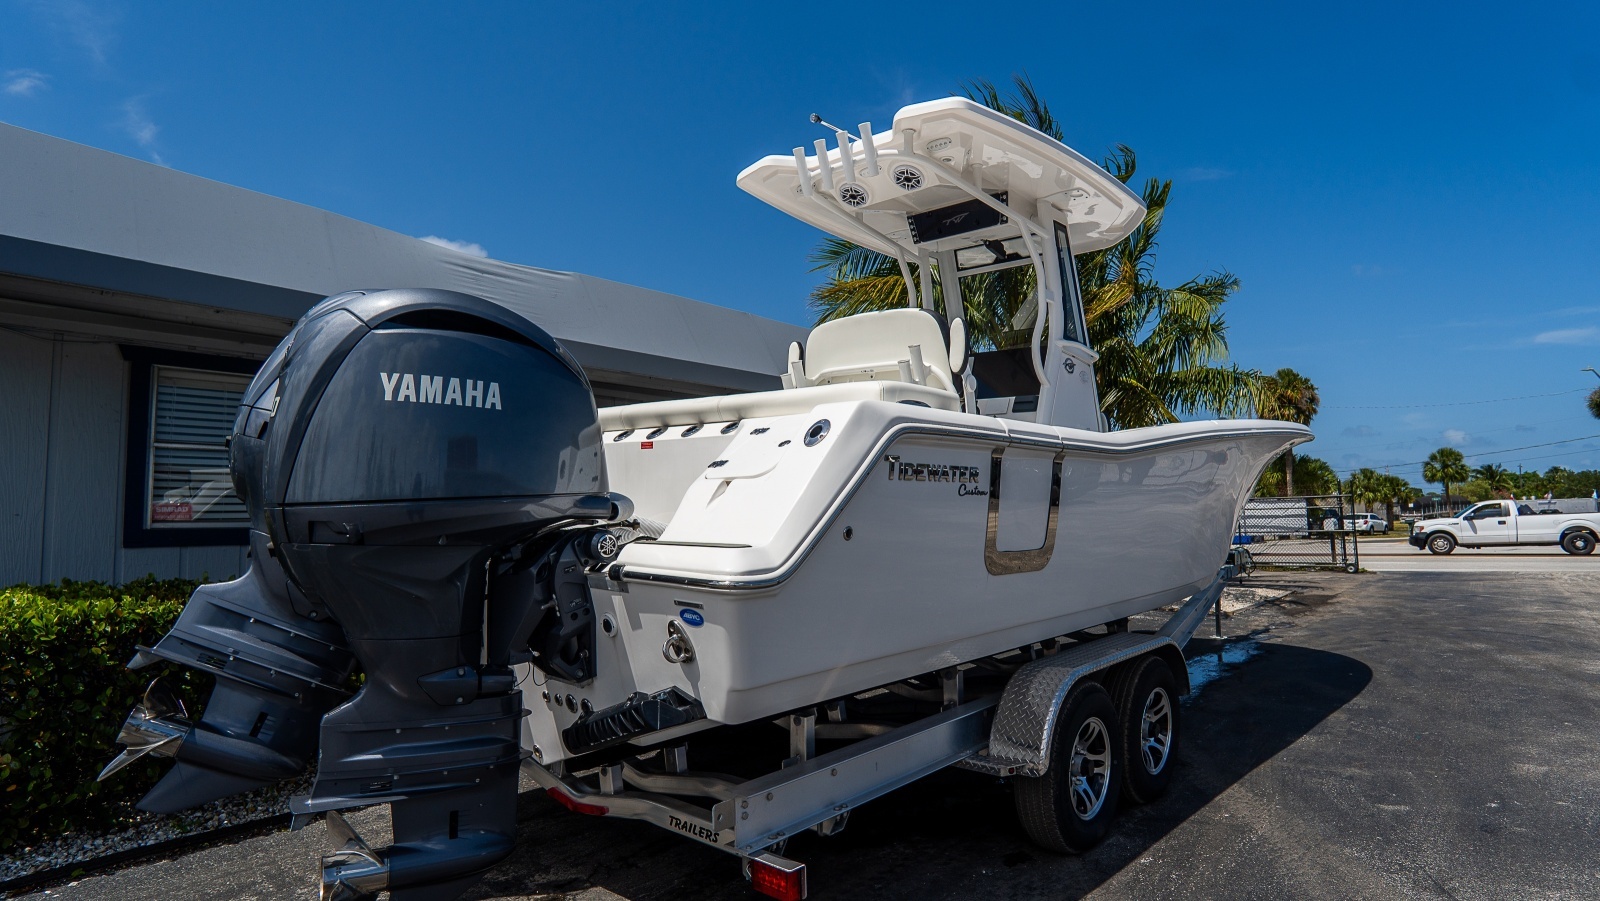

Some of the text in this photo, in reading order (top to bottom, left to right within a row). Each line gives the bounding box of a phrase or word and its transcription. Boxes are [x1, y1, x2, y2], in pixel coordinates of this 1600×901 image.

[380, 372, 502, 411] YAMAHA
[958, 484, 989, 496] Custom
[669, 815, 720, 843] TRAILERS
